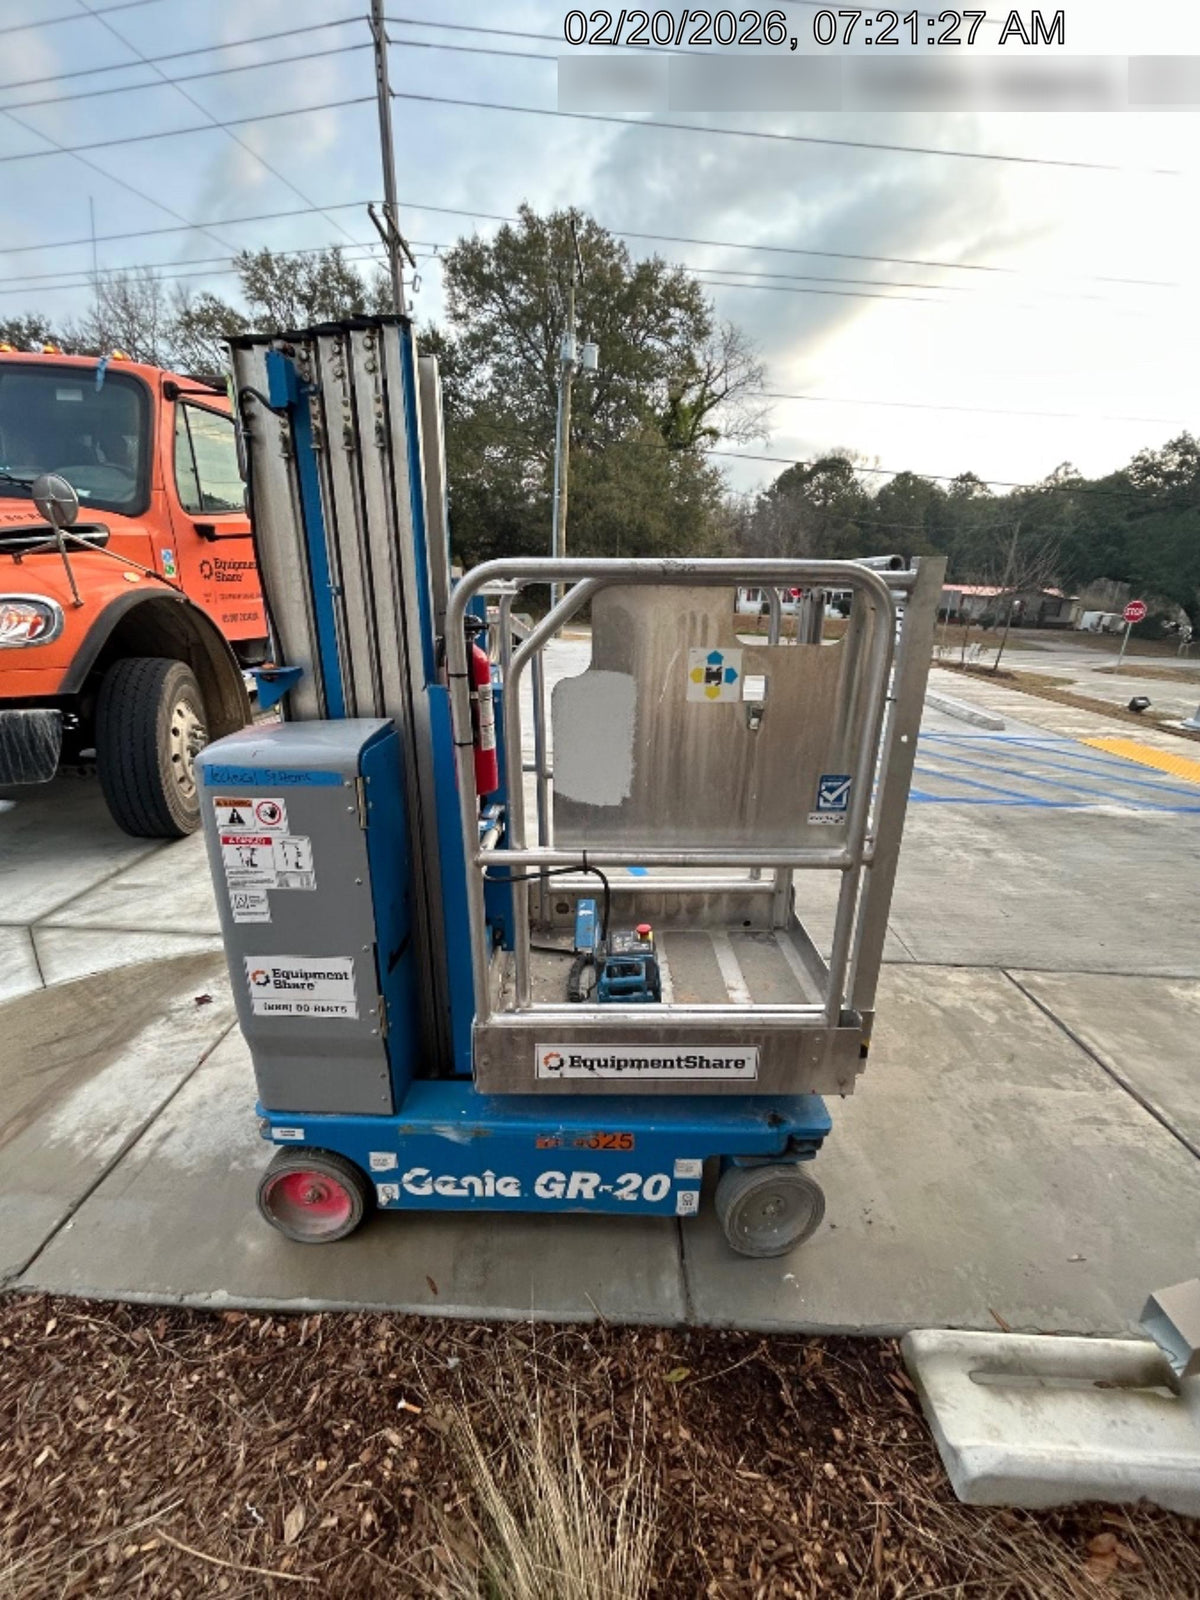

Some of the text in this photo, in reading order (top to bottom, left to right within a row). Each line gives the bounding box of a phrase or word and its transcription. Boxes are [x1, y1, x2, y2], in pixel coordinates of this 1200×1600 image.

[1125, 607, 1143, 616] STOP
[272, 968, 349, 981] Equipment
[273, 979, 315, 991] Share
[568, 1055, 746, 1071] EquipmentShare
[402, 1168, 671, 1202] Genie GR-20
